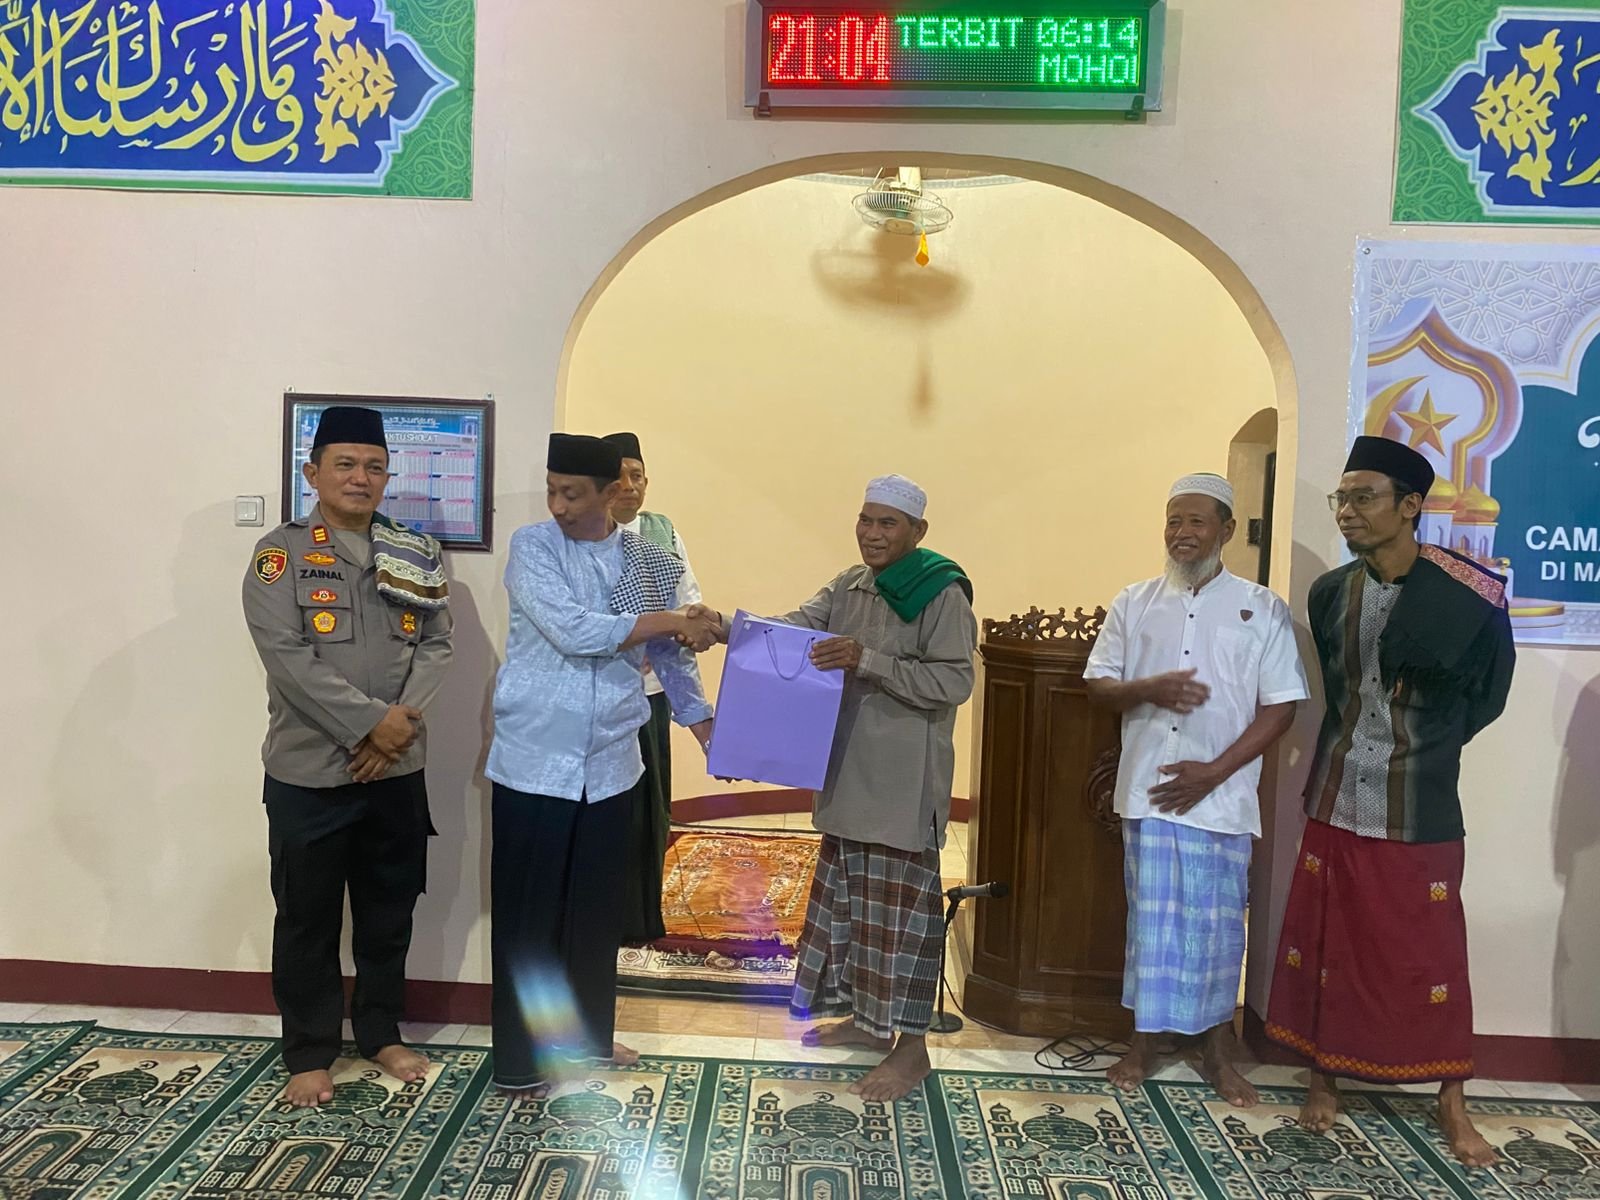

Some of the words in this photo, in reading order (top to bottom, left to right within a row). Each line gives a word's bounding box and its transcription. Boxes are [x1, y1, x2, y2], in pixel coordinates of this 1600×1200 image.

[895, 16, 1024, 48] TERBIT
[1037, 16, 1139, 48] 06:14
[771, 15, 889, 80] 21:04
[1037, 53, 1138, 84] MOHO
[1525, 525, 1600, 552] CAM
[299, 568, 345, 581] ZAINAL
[1541, 561, 1566, 581] DI
